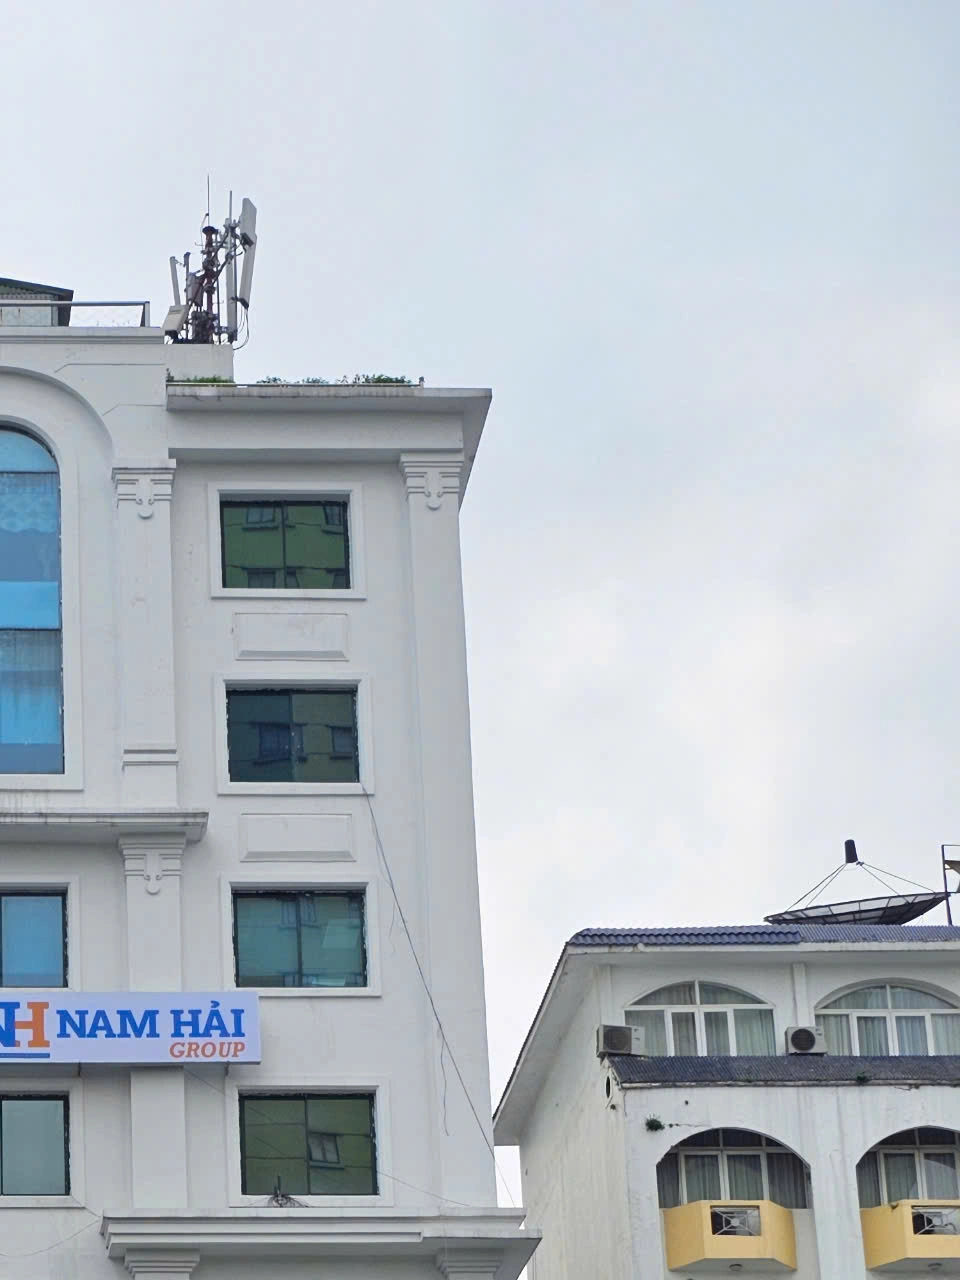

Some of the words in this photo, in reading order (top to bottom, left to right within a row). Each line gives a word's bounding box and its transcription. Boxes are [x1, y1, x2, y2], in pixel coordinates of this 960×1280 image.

[57, 1009, 159, 1039] NAM
[170, 1000, 245, 1038] HẢI
[169, 1041, 246, 1058] GROUP
